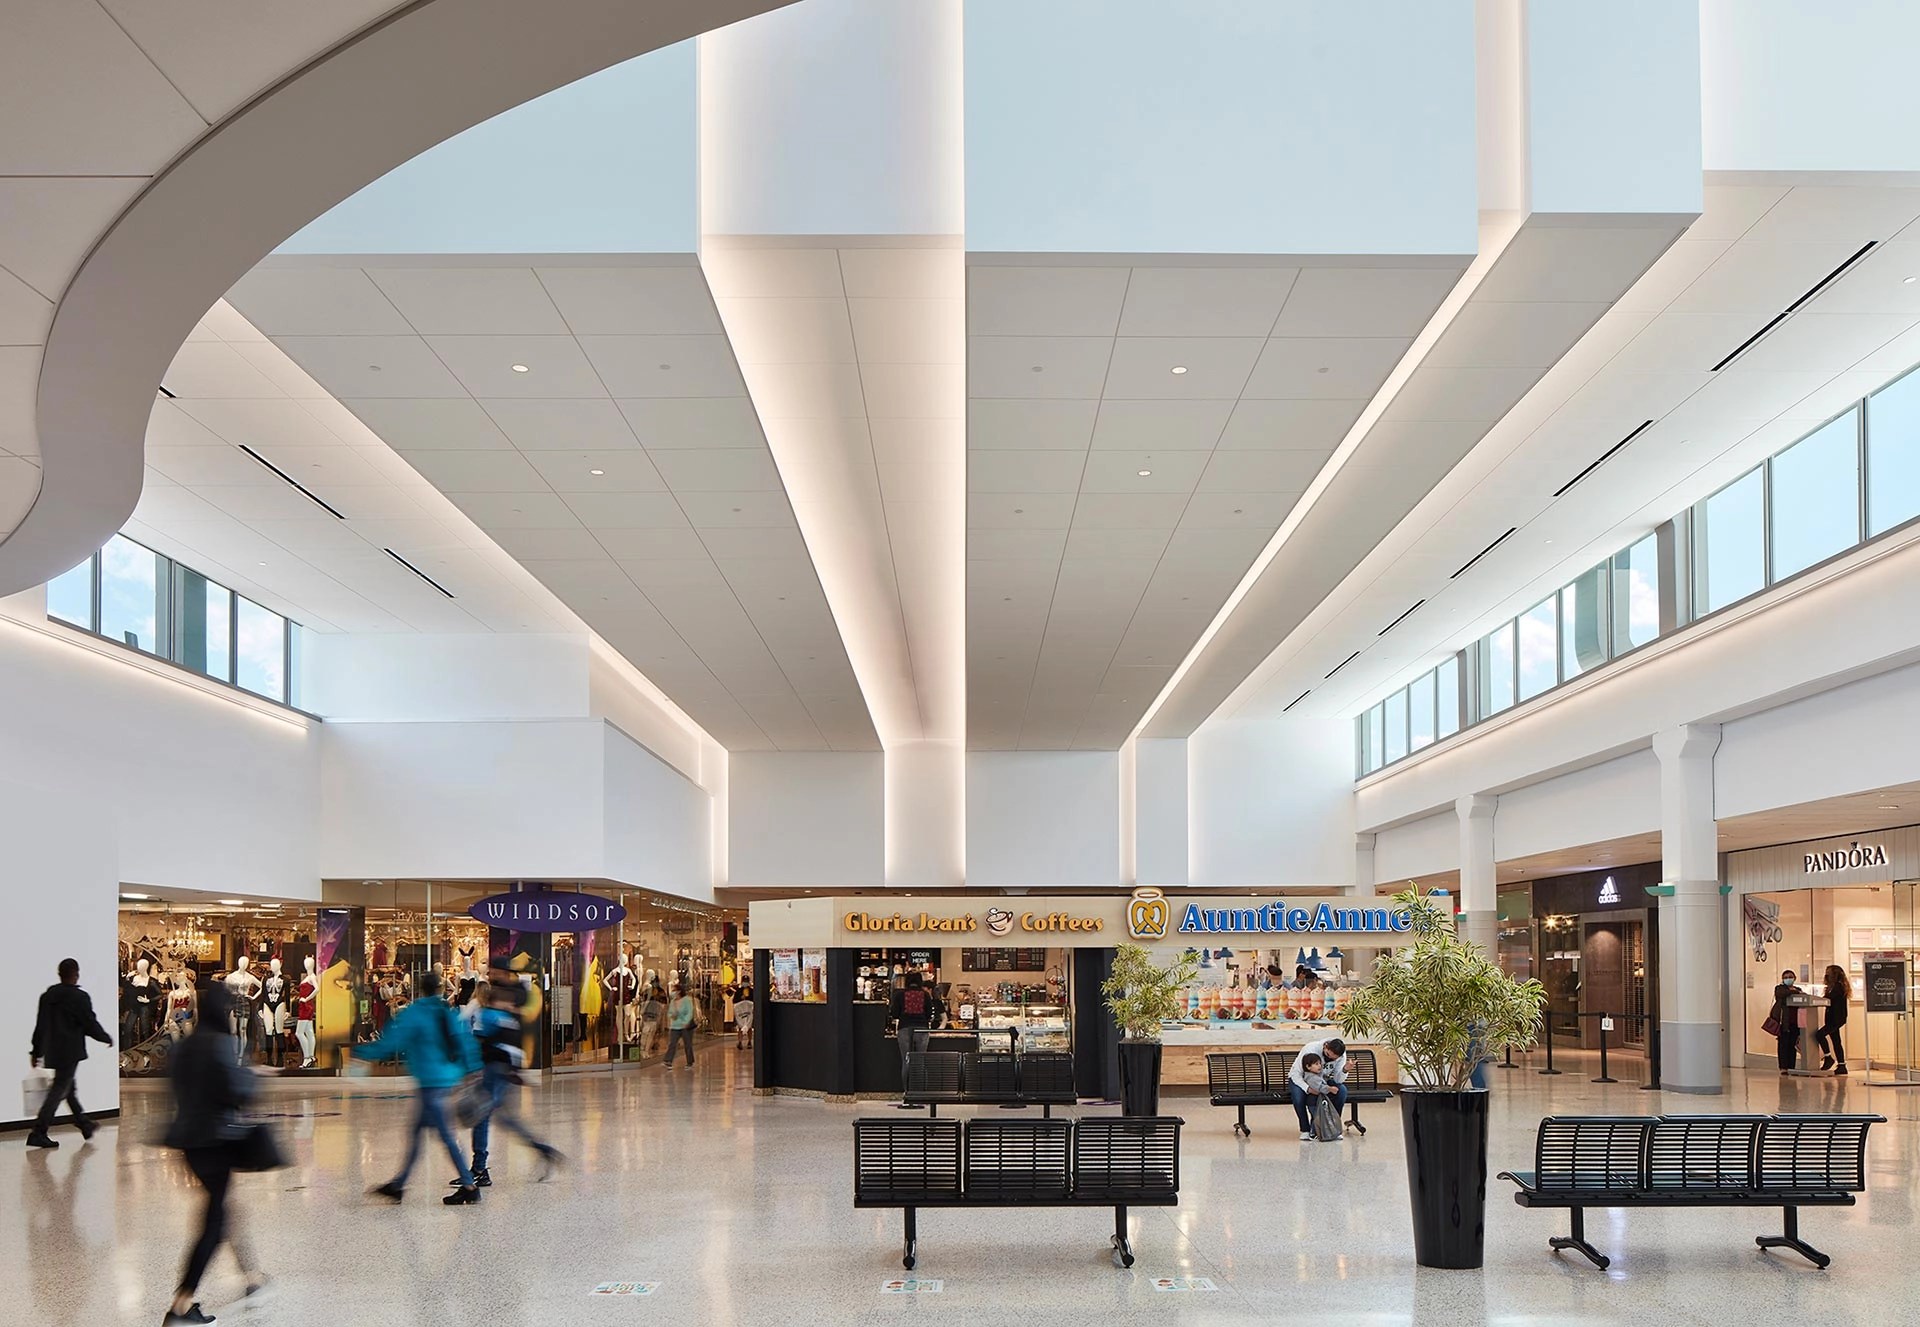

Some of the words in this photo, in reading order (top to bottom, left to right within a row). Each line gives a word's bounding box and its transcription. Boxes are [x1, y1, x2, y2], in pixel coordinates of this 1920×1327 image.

[1803, 845, 1887, 873] PANDORA
[1598, 892, 1619, 904] adidas
[844, 911, 914, 932] Gloria
[917, 911, 977, 932] Jean's
[1021, 911, 1104, 932] Coffees
[1179, 900, 1311, 933] Auntie
